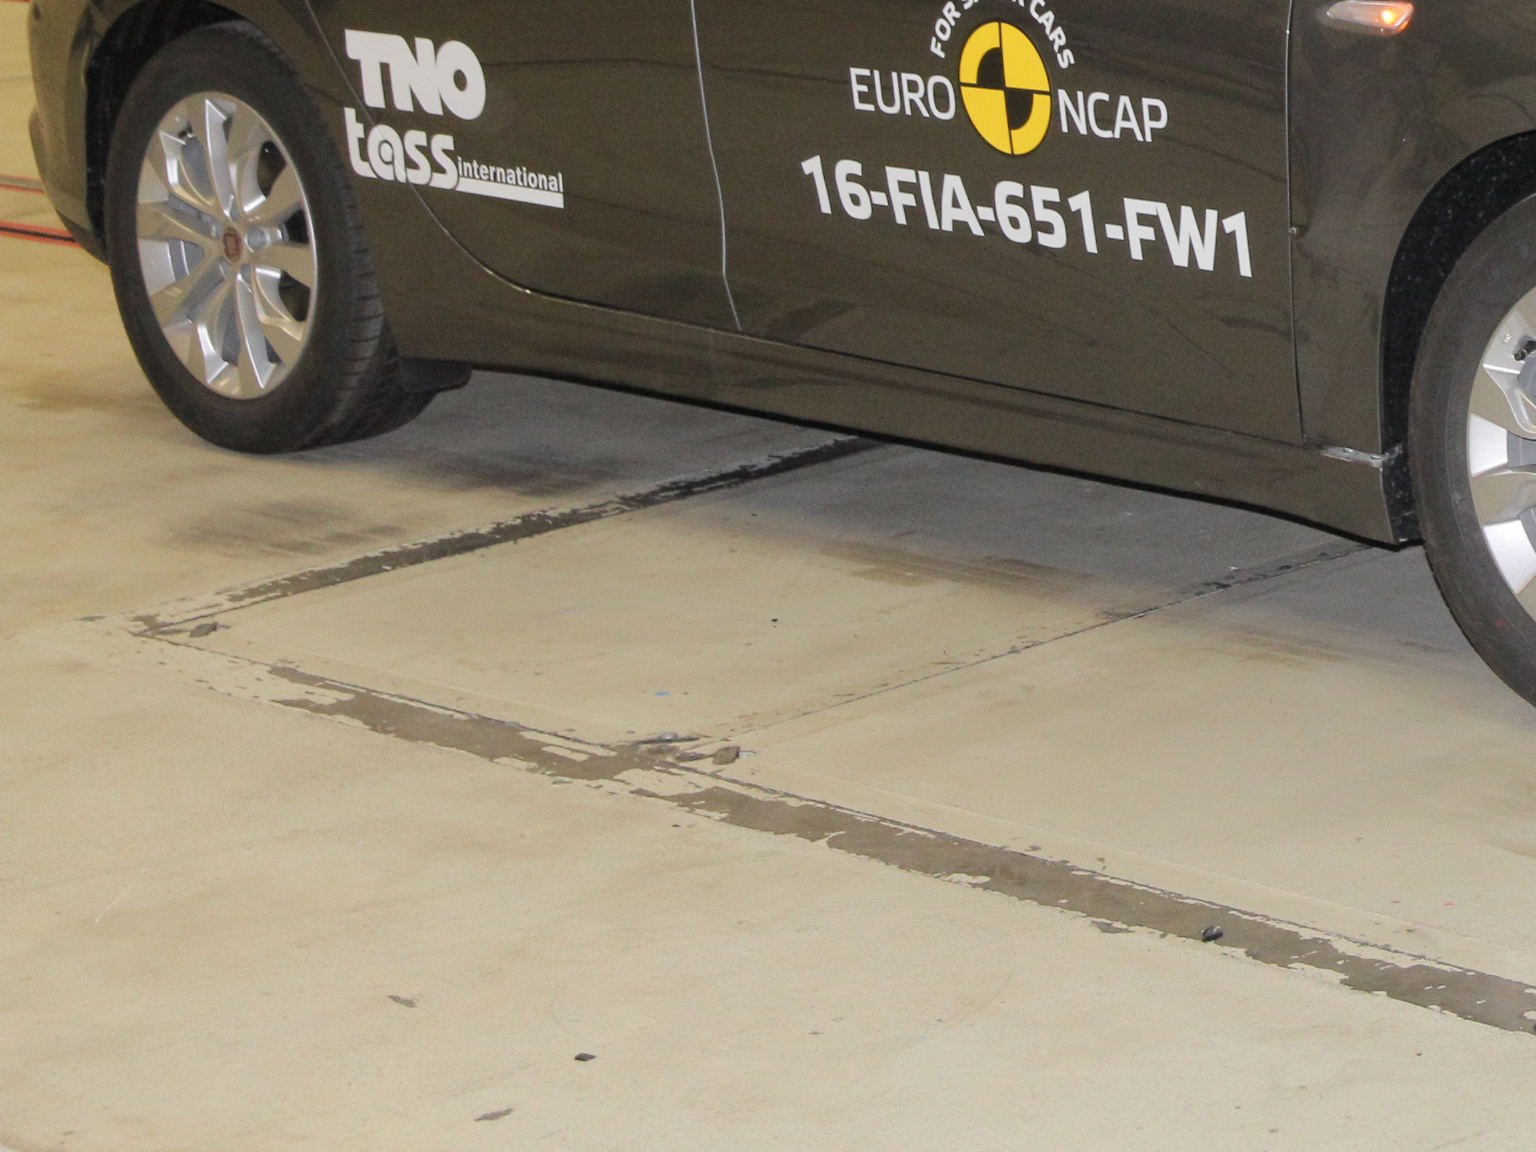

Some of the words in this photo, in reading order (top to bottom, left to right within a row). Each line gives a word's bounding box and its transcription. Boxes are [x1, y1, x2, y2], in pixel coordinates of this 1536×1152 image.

[930, 0, 962, 60] FOR
[344, 28, 487, 121] TNO
[849, 67, 957, 121] EURO
[1057, 88, 1168, 143] NCAP
[344, 106, 460, 190] tass
[456, 156, 565, 193] international
[800, 154, 1253, 278] 16-FIA-651-FW1
